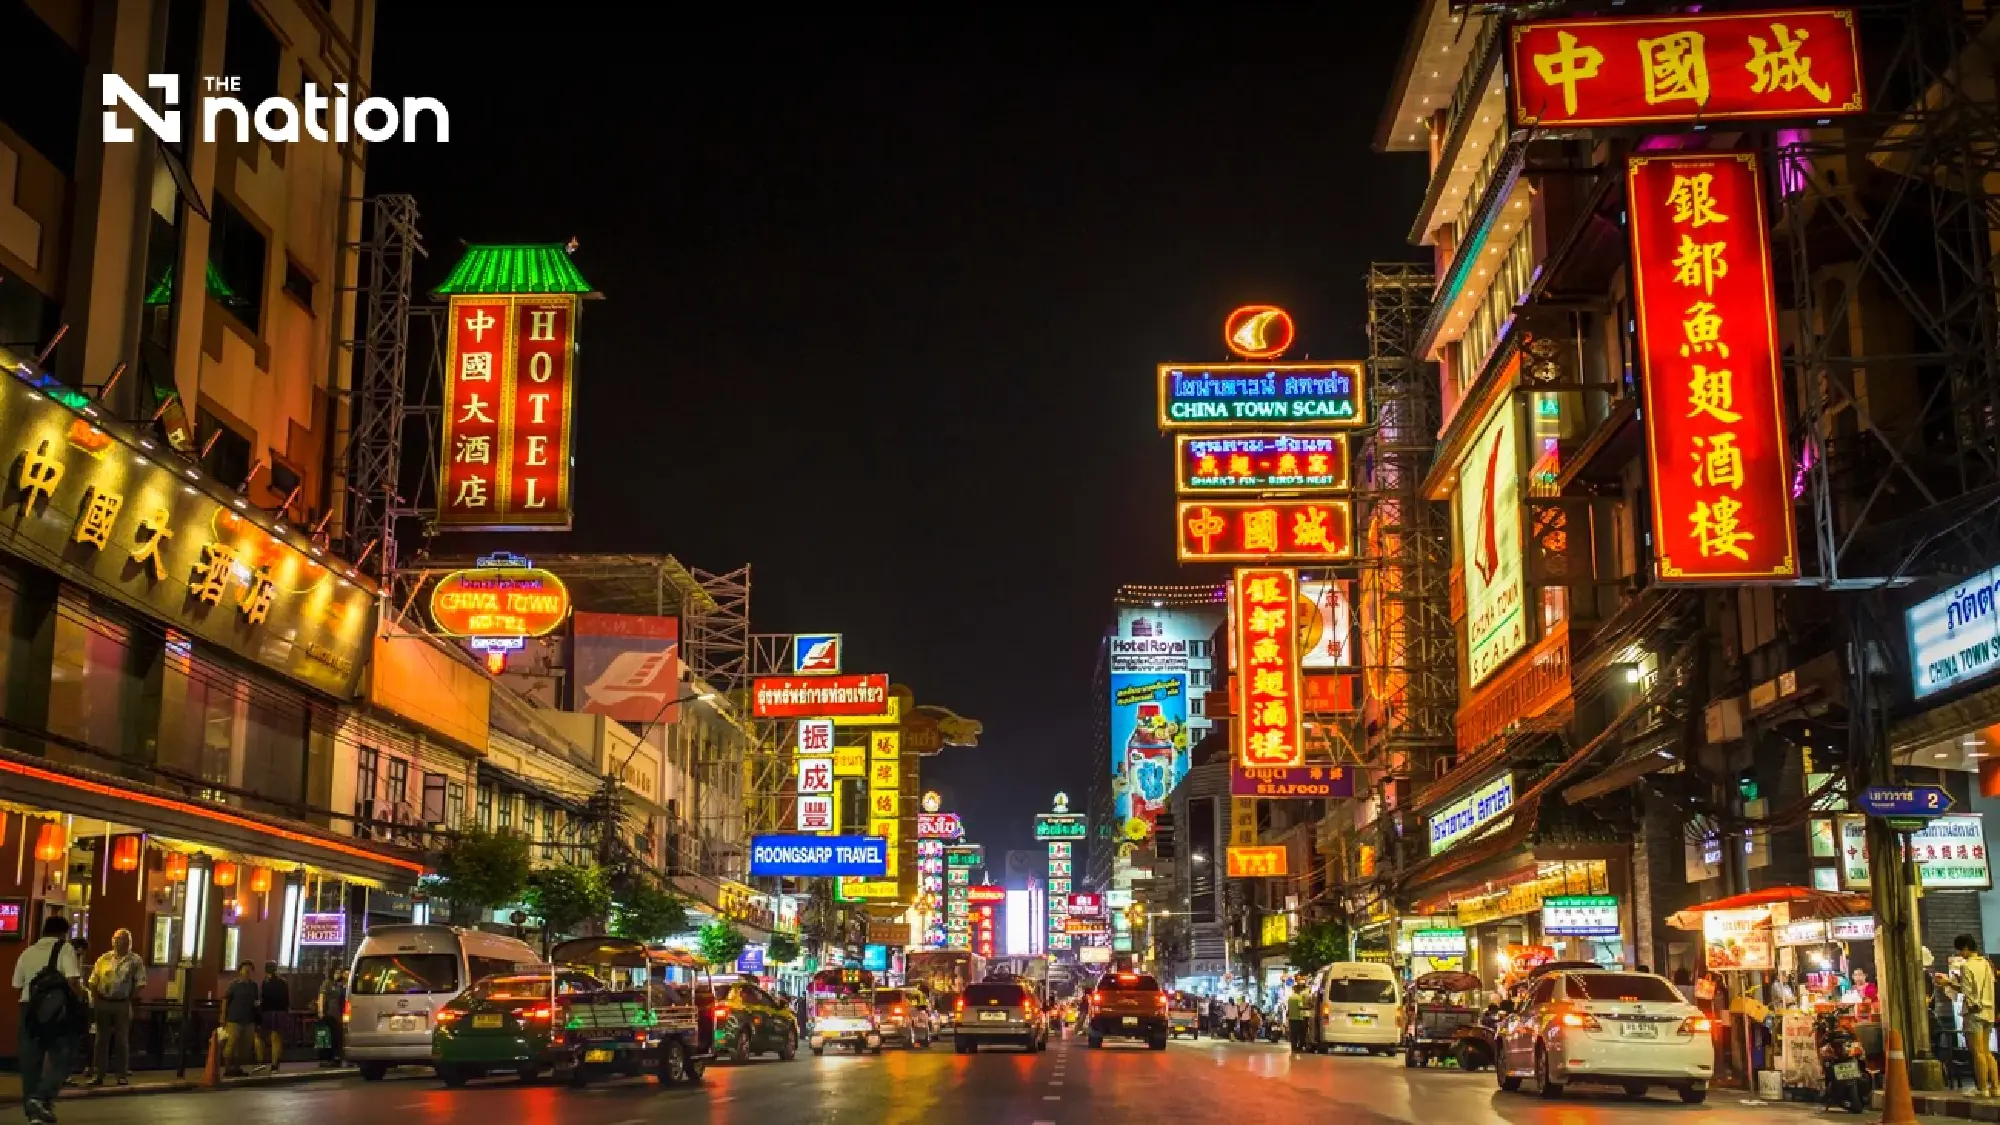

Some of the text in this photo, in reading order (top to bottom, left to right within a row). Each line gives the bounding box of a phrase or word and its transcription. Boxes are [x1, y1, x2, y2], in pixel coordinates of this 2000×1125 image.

[1532, 23, 1832, 117] 中國城
[1664, 173, 1757, 563] 銀都魚翅酒樓
[453, 308, 495, 509] 中國大酒店
[524, 310, 558, 509] HOTEL
[1171, 400, 1353, 418] CHINA TOWN SCALA
[18, 439, 276, 625] 中國大酒店
[1188, 506, 1336, 554] 中國城
[440, 592, 560, 614] CHINA TOWN
[469, 614, 527, 632] HOTEL
[1113, 639, 1187, 655] Hotel Royal
[1473, 622, 1521, 681] SCALA
[1928, 654, 1958, 684] CHINA
[1959, 640, 1990, 672] TOWN
[1256, 783, 1330, 795] SEAFOOD
[1927, 793, 1939, 809] 2
[754, 846, 883, 864] ROONGSARP TRAVEL
[307, 930, 339, 940] HOTEL
